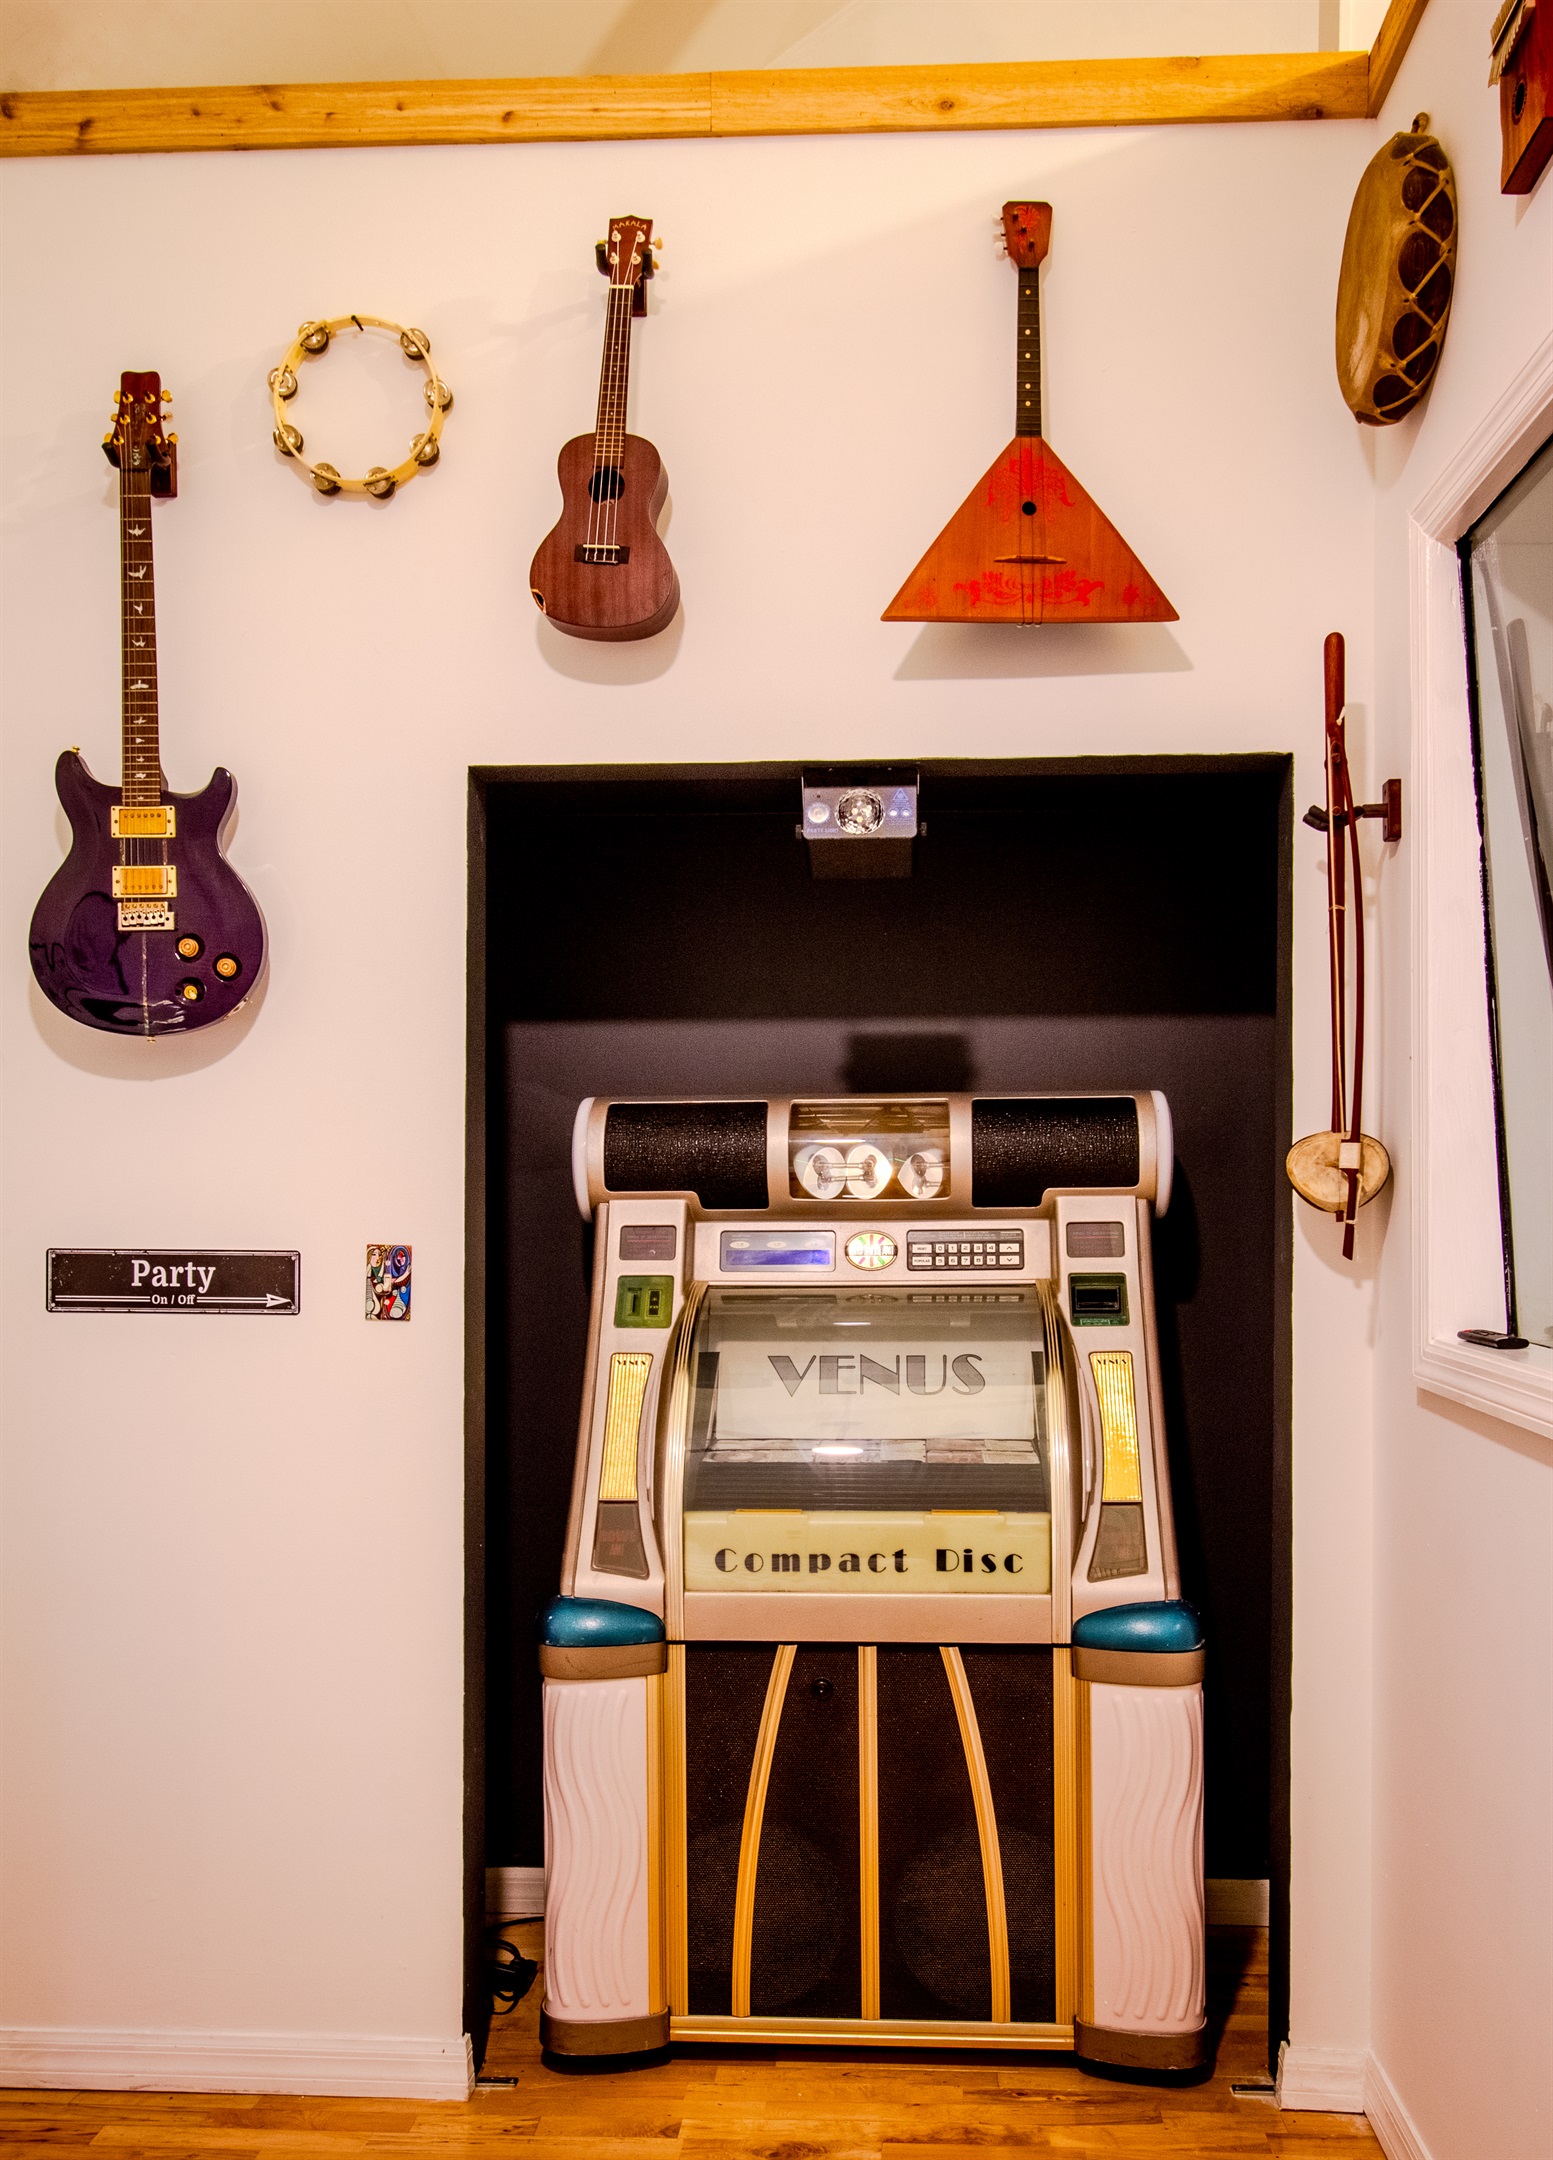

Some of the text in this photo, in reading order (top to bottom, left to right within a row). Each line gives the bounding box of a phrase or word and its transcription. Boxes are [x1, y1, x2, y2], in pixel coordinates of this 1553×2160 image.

[612, 220, 647, 231] MAKALA
[131, 1259, 217, 1294] Party
[151, 1294, 196, 1305] On / Off
[767, 1353, 986, 1397] VENUS
[714, 1548, 1025, 1574] Compact Disc
